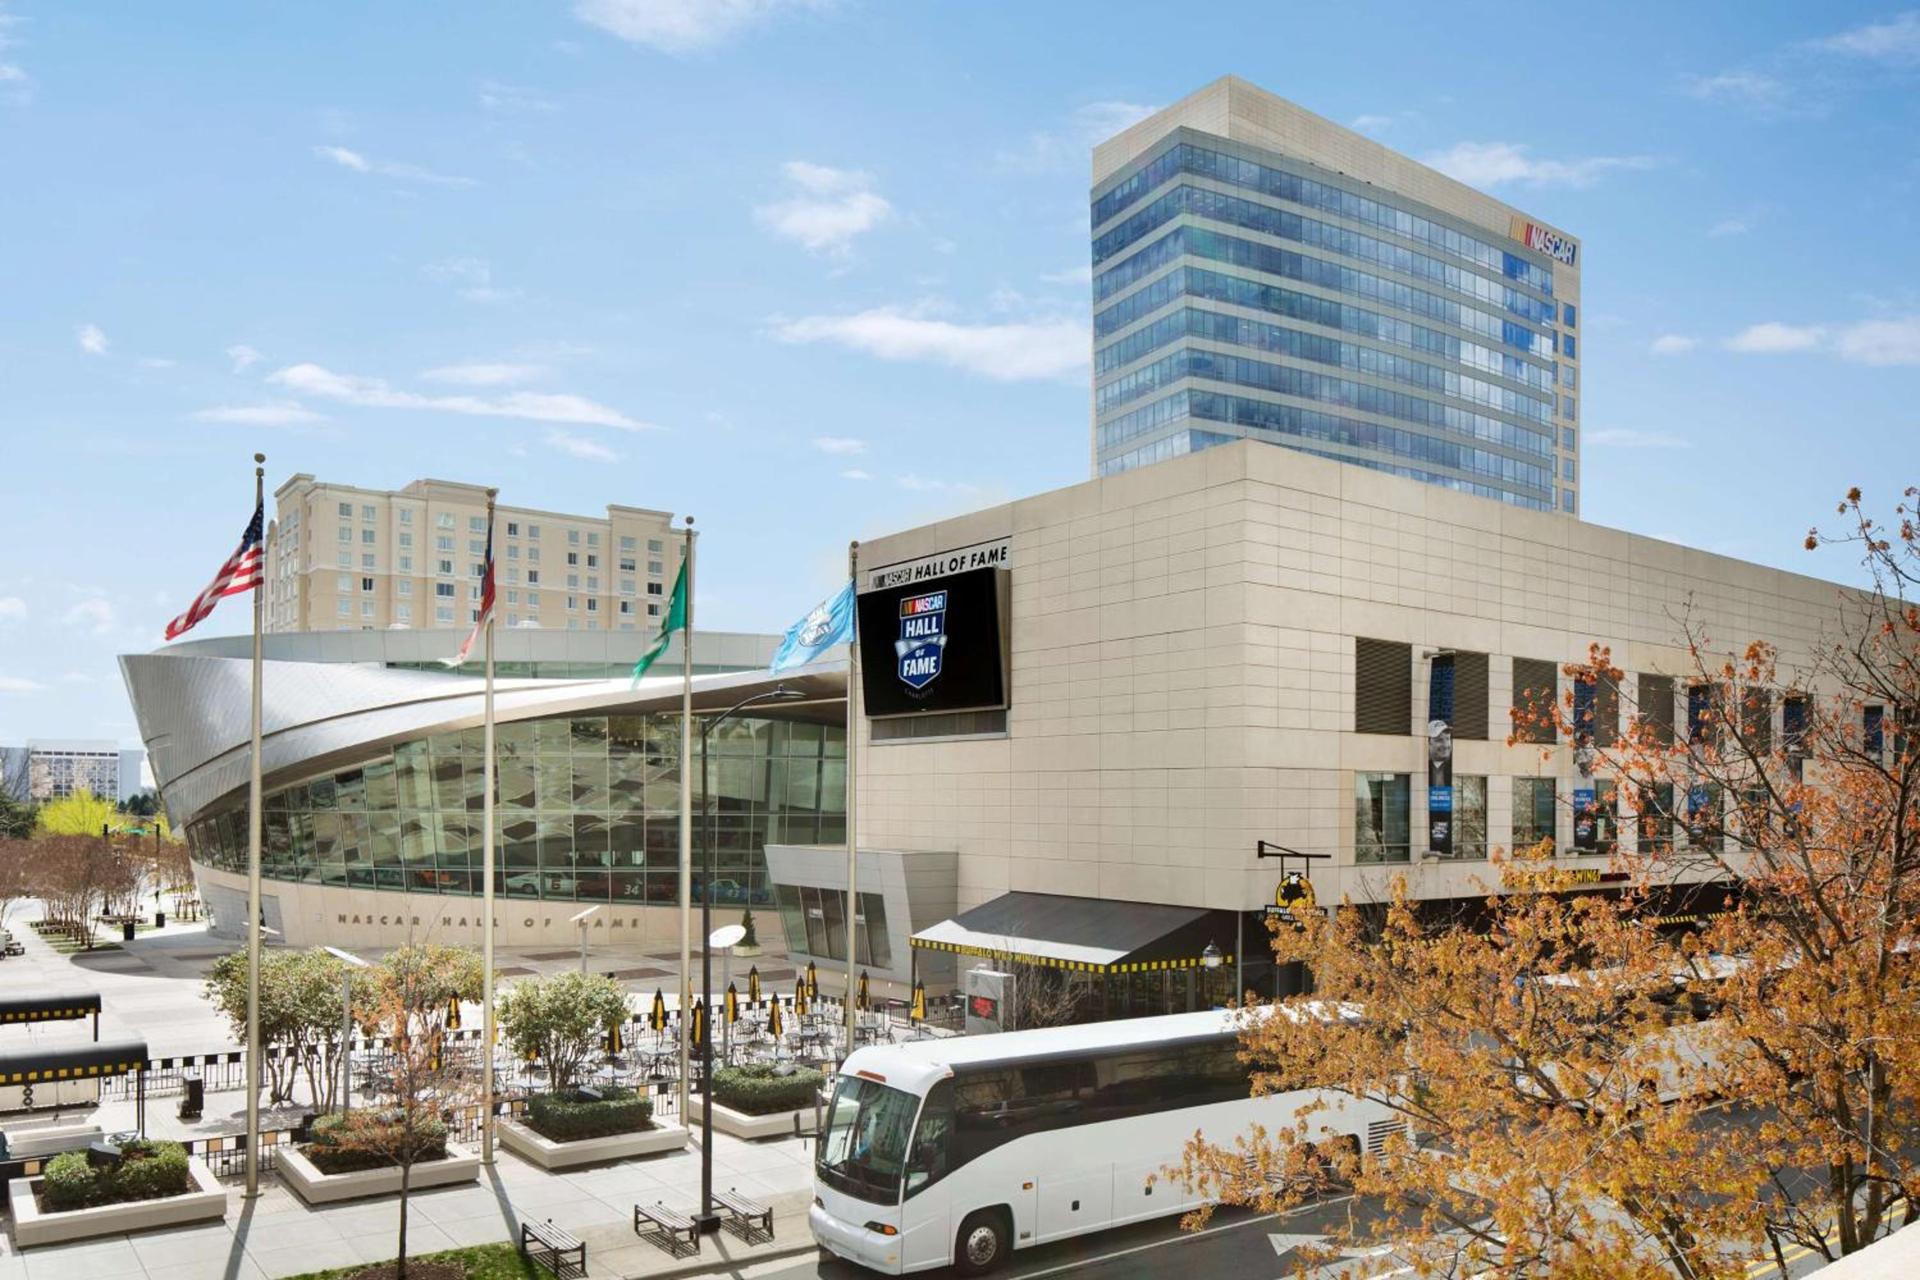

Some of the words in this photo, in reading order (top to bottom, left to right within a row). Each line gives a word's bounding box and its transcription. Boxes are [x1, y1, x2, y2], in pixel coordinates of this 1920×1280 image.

[1530, 224, 1575, 266] NASCAR
[915, 561, 945, 580] HALL
[948, 556, 966, 572] OF
[970, 546, 1007, 567] FAME
[914, 594, 943, 613] NASCAR
[905, 616, 939, 638] HALL
[903, 656, 938, 677] FAME
[337, 913, 421, 926] NASCAR
[442, 916, 499, 928] HALL
[523, 917, 552, 928] OF
